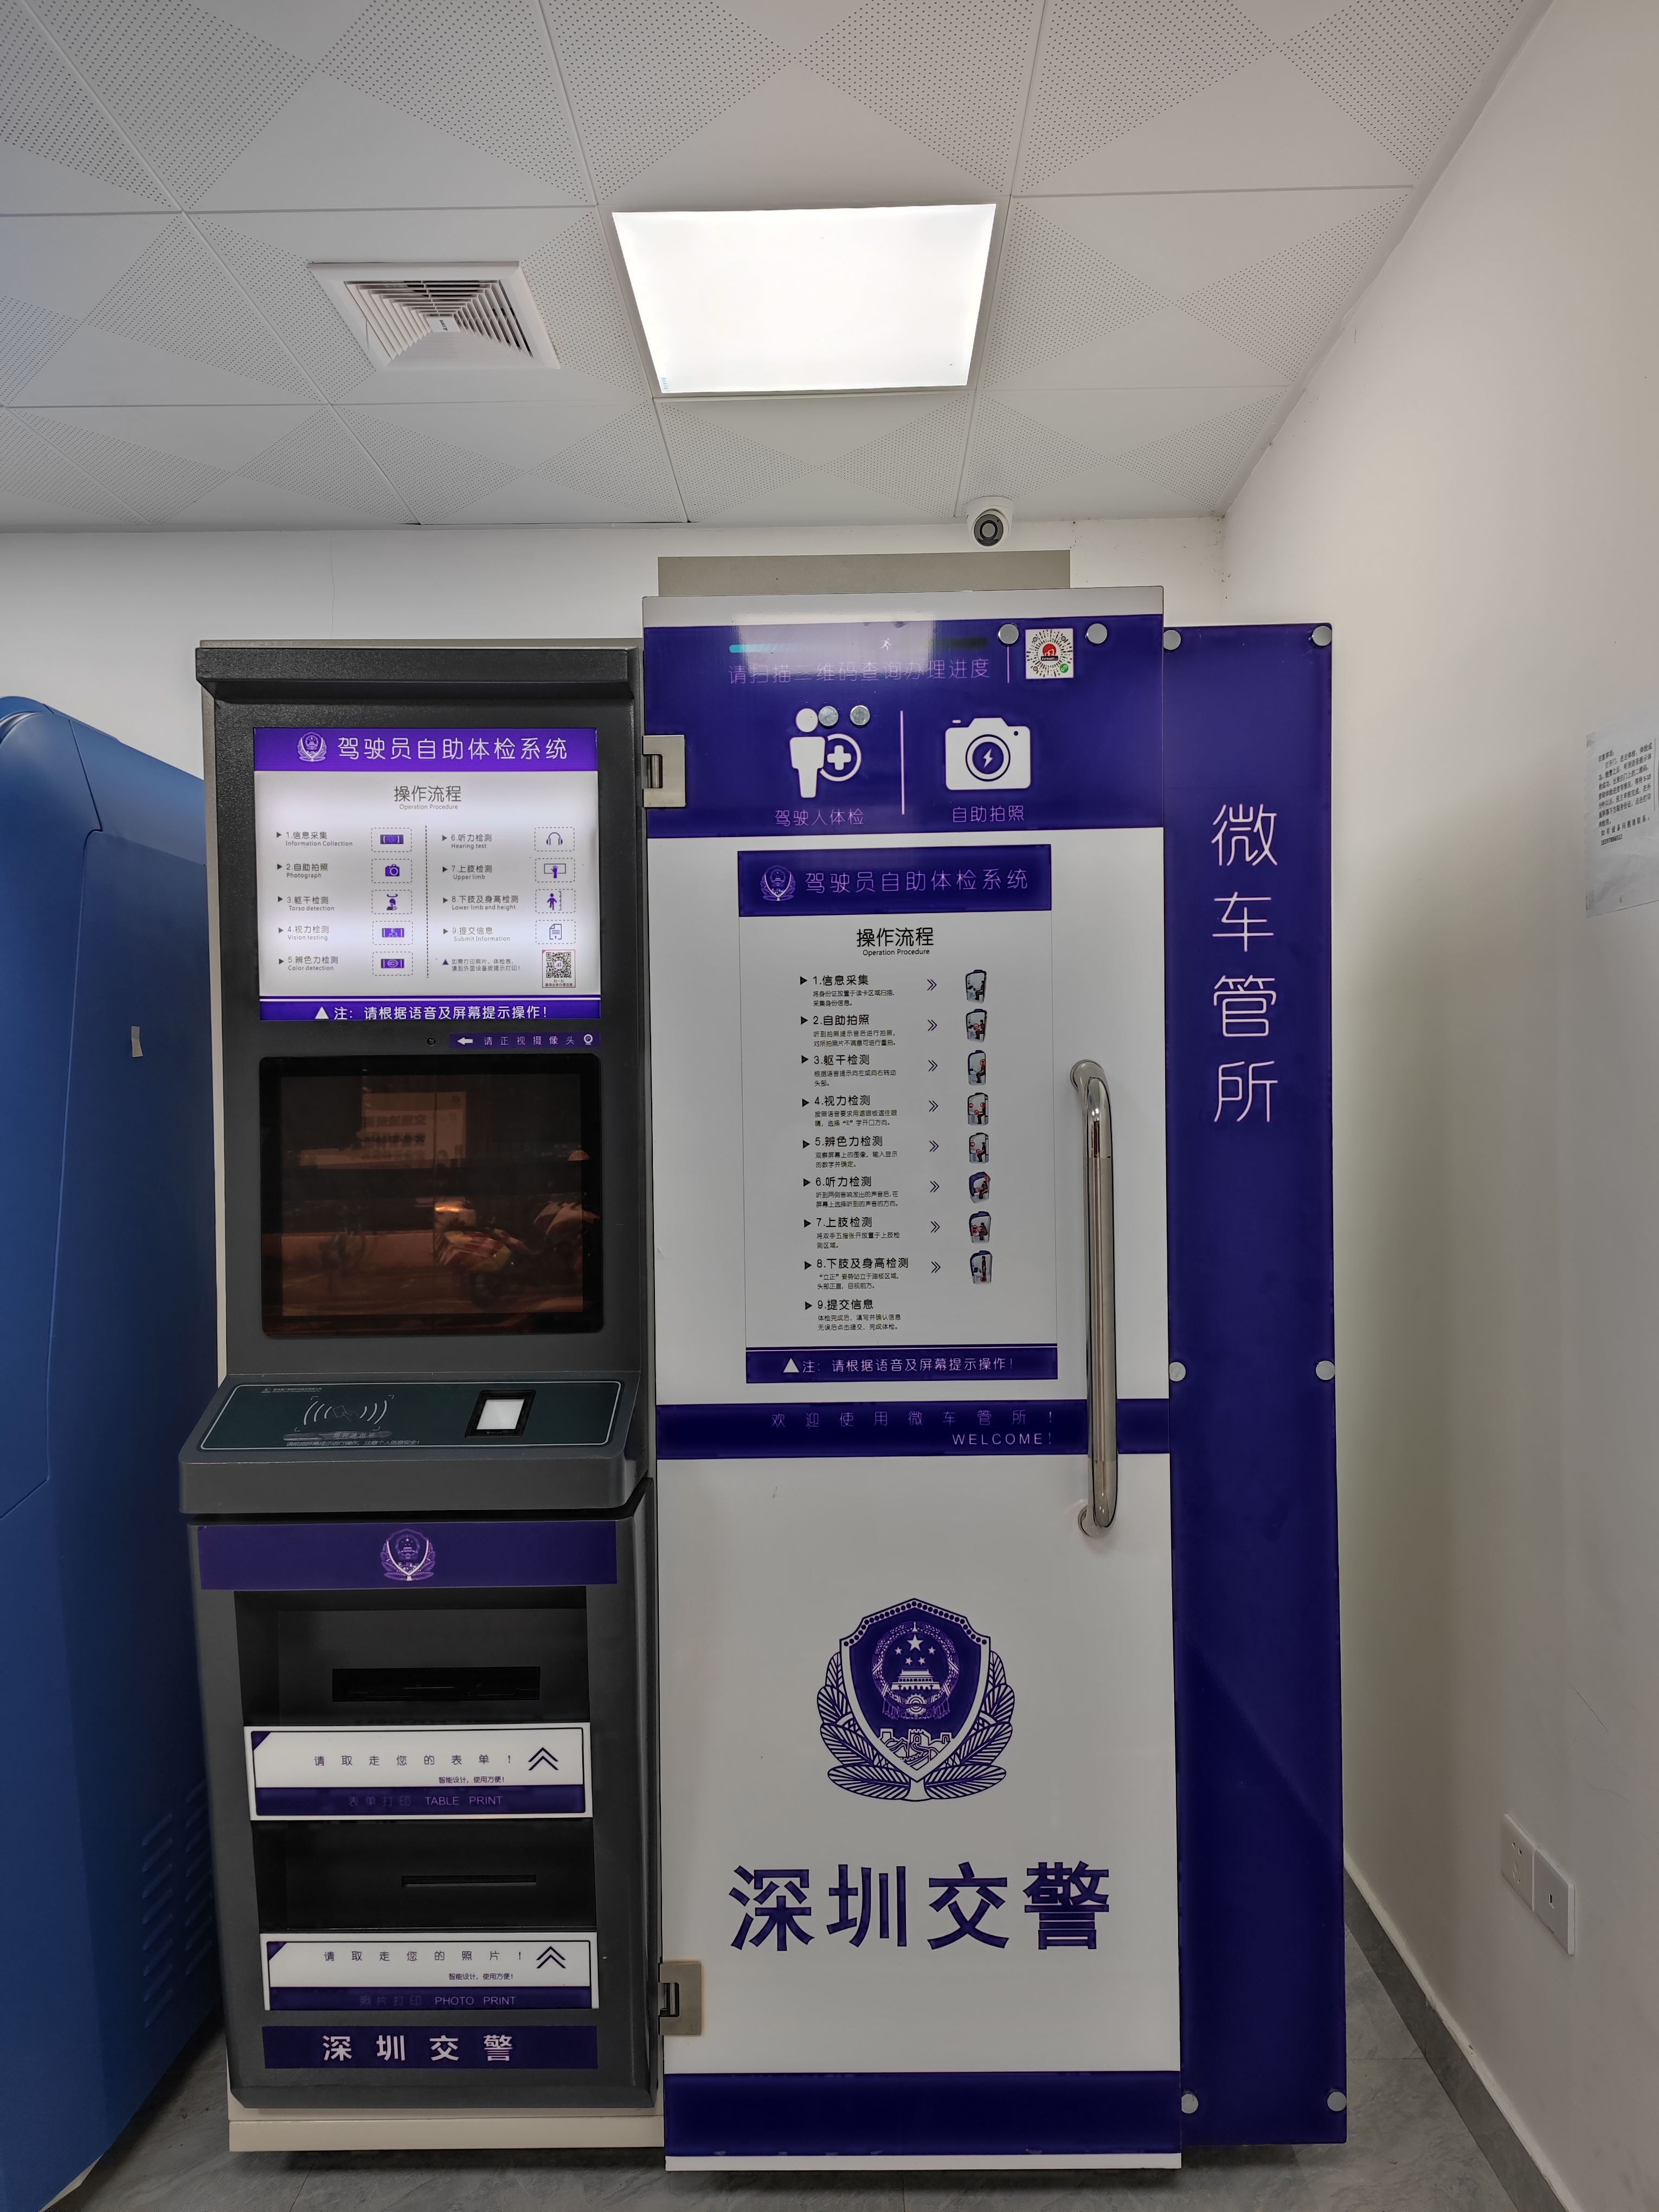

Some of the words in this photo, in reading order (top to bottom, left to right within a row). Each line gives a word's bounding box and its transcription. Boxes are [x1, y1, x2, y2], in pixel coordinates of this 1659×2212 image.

[729, 658, 991, 685] 请扫描二维码查询办理进度
[337, 737, 568, 760] 驾驶员自助体检系统
[394, 785, 461, 803] 操作流程
[774, 808, 864, 827] 驾驶人体检
[953, 805, 1024, 823] 自助拍照
[286, 831, 328, 840] 1.信息采集
[451, 834, 492, 842] 6.听力检测
[286, 863, 329, 871] 2.自助拍照
[451, 865, 492, 873] 7.上肢检测
[805, 868, 1028, 894] 驾驶员自助体检系统
[287, 896, 329, 904] 3.躯干检测
[452, 895, 519, 904] 8.下肢及身高检测
[287, 925, 329, 934] 4.视力检测
[857, 927, 934, 948] 操作流程
[288, 956, 338, 964] 5.辨色力检测
[1211, 803, 1278, 1122] 微车管所
[813, 974, 869, 986] 1.信息采集
[813, 1014, 870, 1026] 2.自助拍照
[484, 1036, 575, 1046] 请正视摄像头
[814, 1054, 870, 1066] 3.躯干检测
[814, 1095, 870, 1107] 4.视力检测
[815, 1136, 883, 1147] 5.辨色力检测
[815, 1176, 872, 1187] 6.听力检测
[816, 1217, 872, 1228] 7.上肢检测
[816, 1257, 909, 1269] 8.下肢及身高检测
[817, 1299, 873, 1310] 9.提交信息
[771, 1410, 1052, 1429] 欢迎使用微车管所！
[952, 1432, 1052, 1445] WELCOME!
[314, 1753, 511, 1766] 请取走您的表单！
[348, 1795, 411, 1808] 表单打印
[425, 1796, 460, 1806] TABLE
[469, 1796, 503, 1806] PRINT
[728, 1860, 1109, 1952] 深圳交警
[323, 1950, 522, 1962] 请取走您的照片！
[359, 1995, 422, 2007] 照片打印
[435, 1996, 474, 2005] PHOTO
[483, 1996, 516, 2005] PRINT
[322, 2035, 513, 2061] 深圳交警
